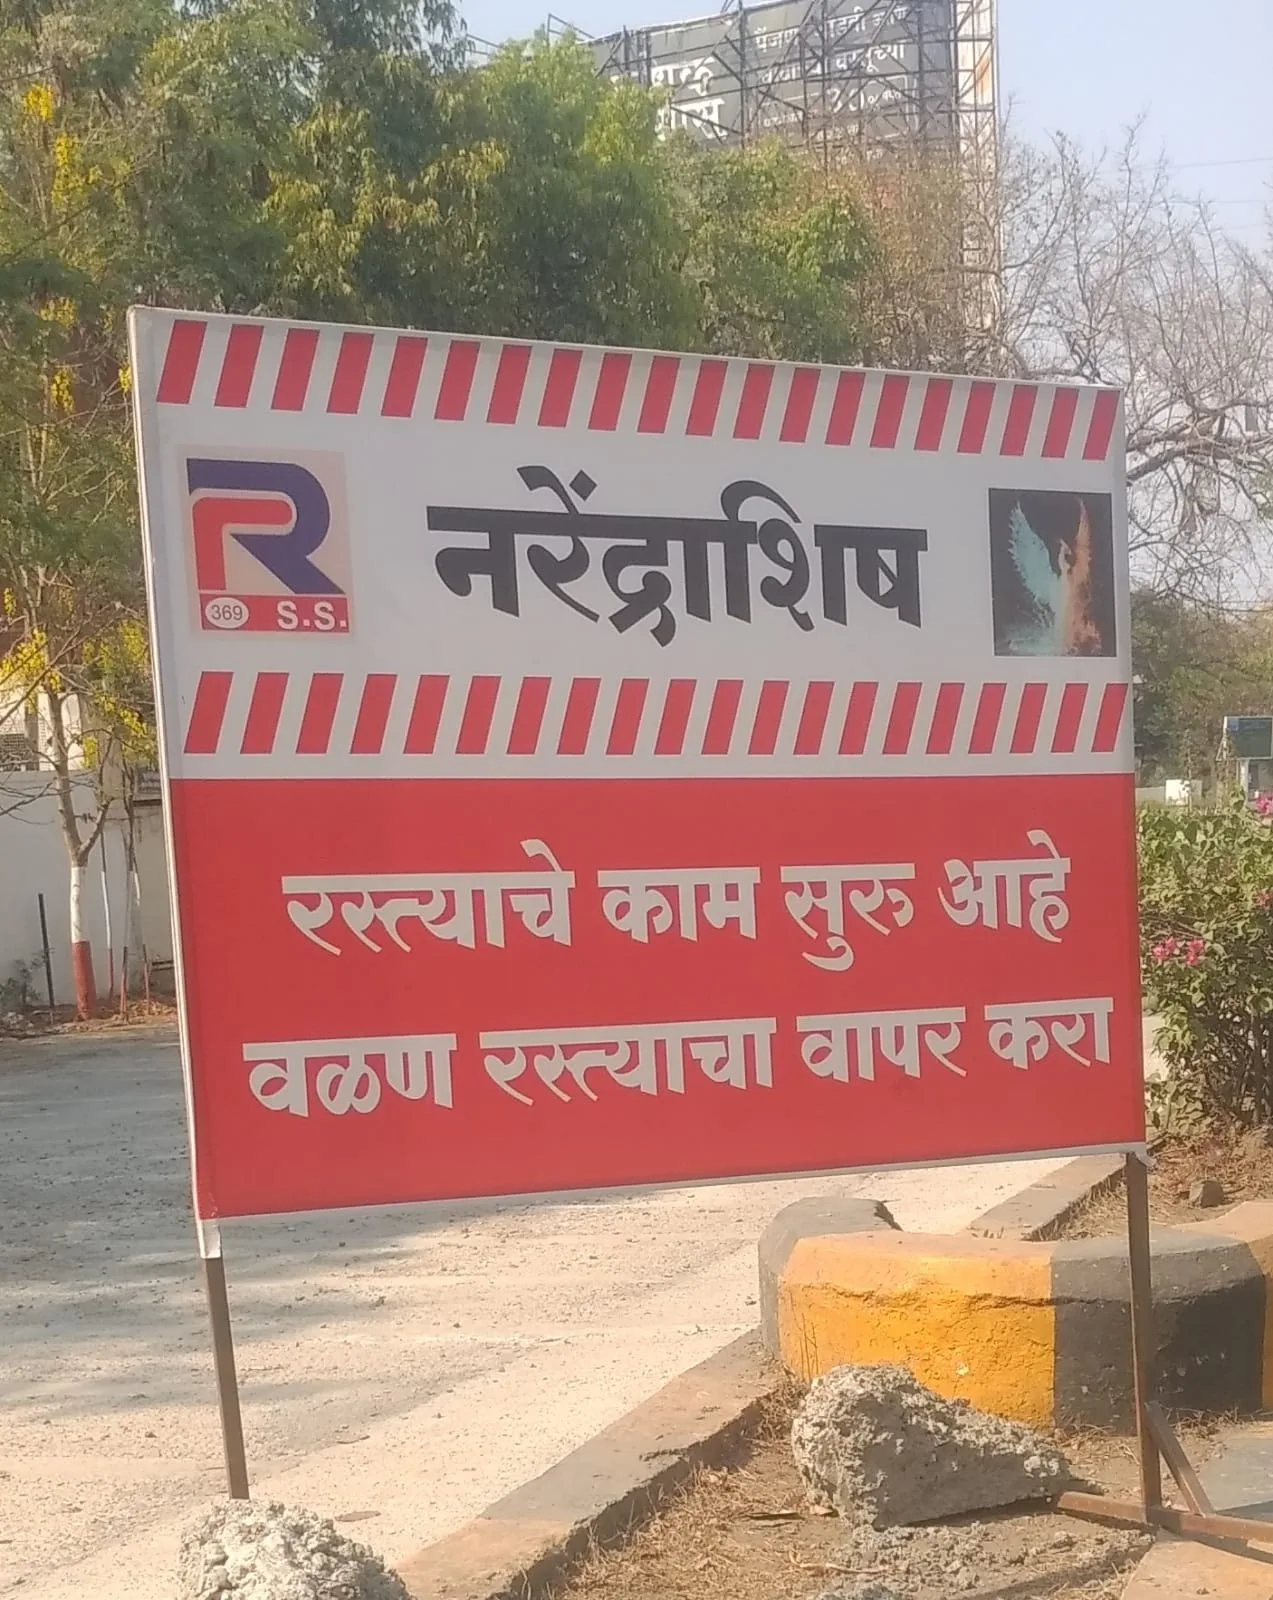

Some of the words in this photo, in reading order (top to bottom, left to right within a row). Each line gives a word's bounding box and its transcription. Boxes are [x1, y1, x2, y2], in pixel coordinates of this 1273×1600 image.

[186, 457, 346, 595] R
[425, 464, 928, 647] नरेंद्राशिष
[210, 604, 243, 621] 369
[276, 600, 347, 630] S.S.
[281, 838, 576, 956] रस्त्याचे
[597, 866, 761, 944] काम
[937, 829, 1071, 943] आहे
[242, 1033, 457, 1117] वळण
[479, 1017, 777, 1106] रस्त्याचा
[796, 1006, 967, 1083] वापर
[984, 997, 1114, 1070] करा
